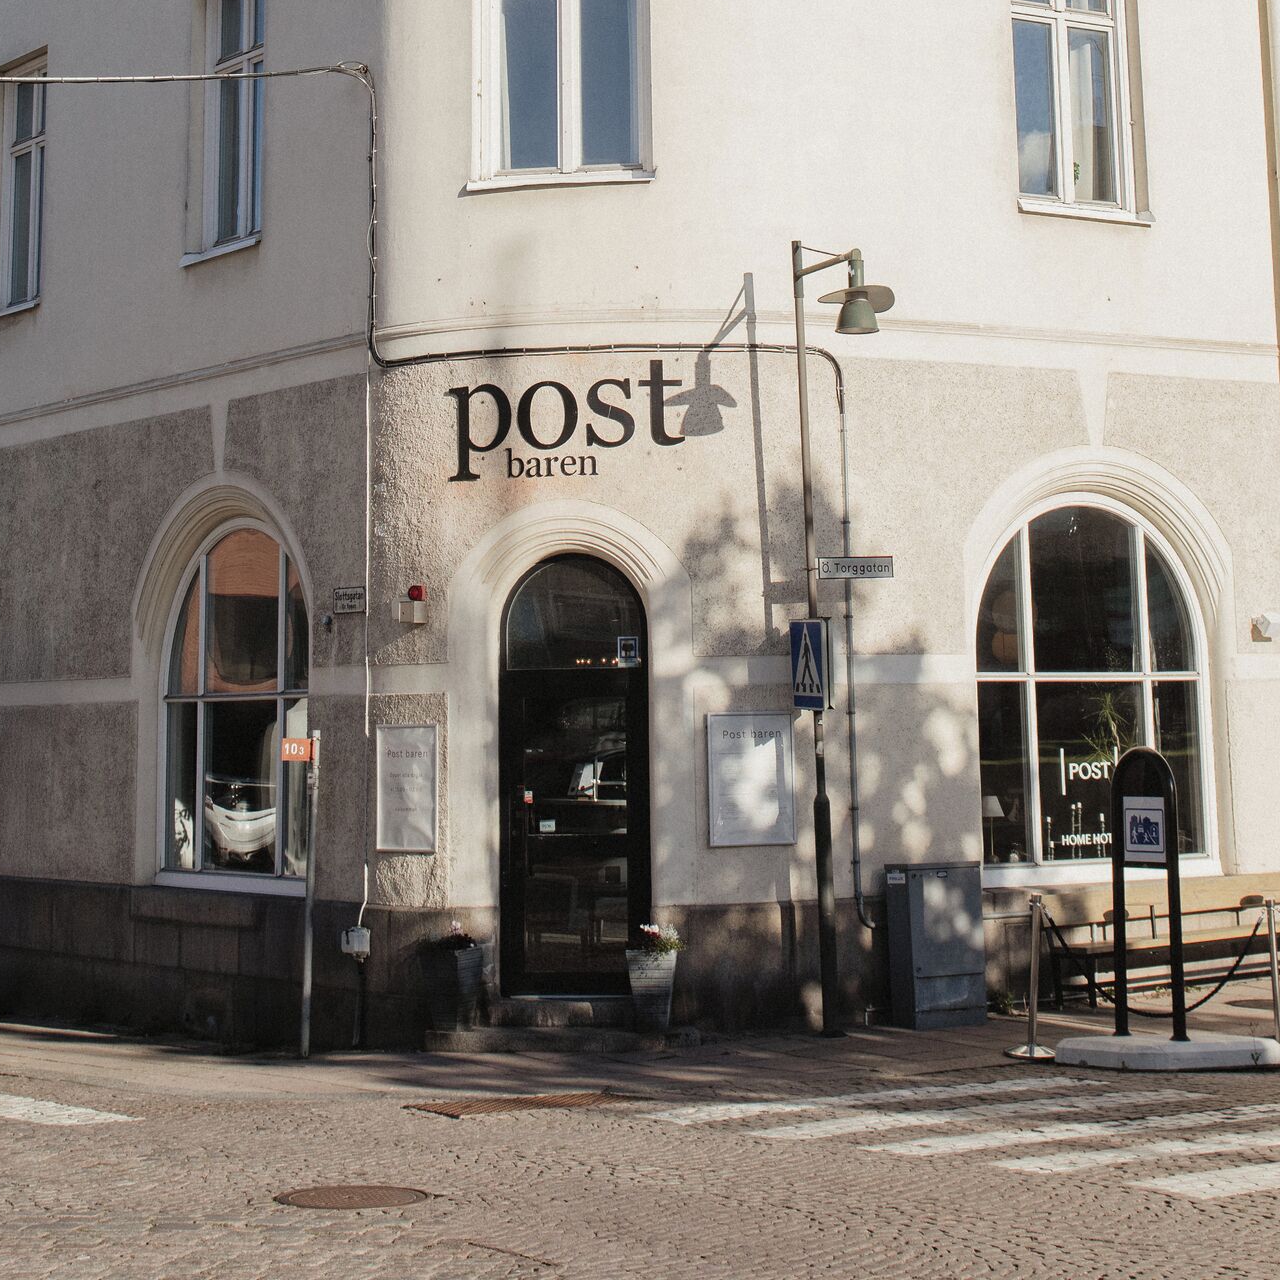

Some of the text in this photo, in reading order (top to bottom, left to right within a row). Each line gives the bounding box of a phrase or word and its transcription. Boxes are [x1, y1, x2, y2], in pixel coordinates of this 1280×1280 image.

[447, 359, 686, 483] post
[505, 448, 599, 478] baren
[822, 561, 890, 575] Ö. Torggatan
[722, 729, 782, 740] Post baren
[387, 749, 428, 759] Post baren
[1068, 761, 1111, 780] POST
[1061, 832, 1112, 846] HOME HOT
